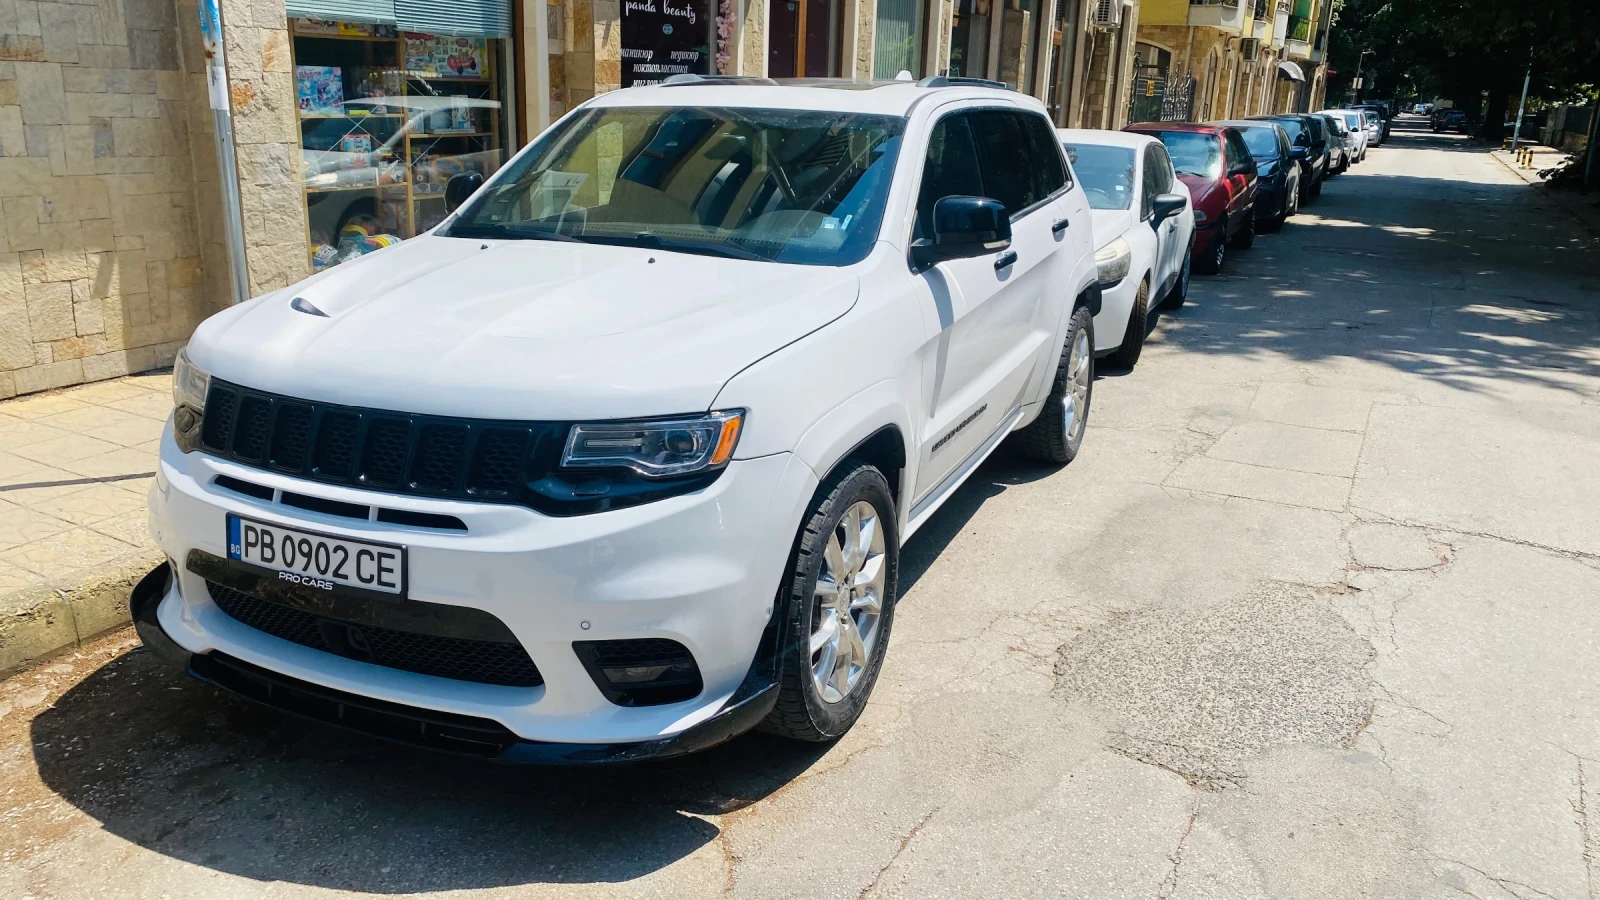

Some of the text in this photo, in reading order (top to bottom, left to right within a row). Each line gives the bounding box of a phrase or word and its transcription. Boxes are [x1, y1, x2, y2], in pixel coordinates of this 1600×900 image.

[625, 0, 696, 24] panda beauty
[670, 50, 699, 63] педикюр
[230, 543, 241, 554] BG
[244, 525, 396, 588] PB 0902 CE
[279, 571, 334, 591] PRO CARS
